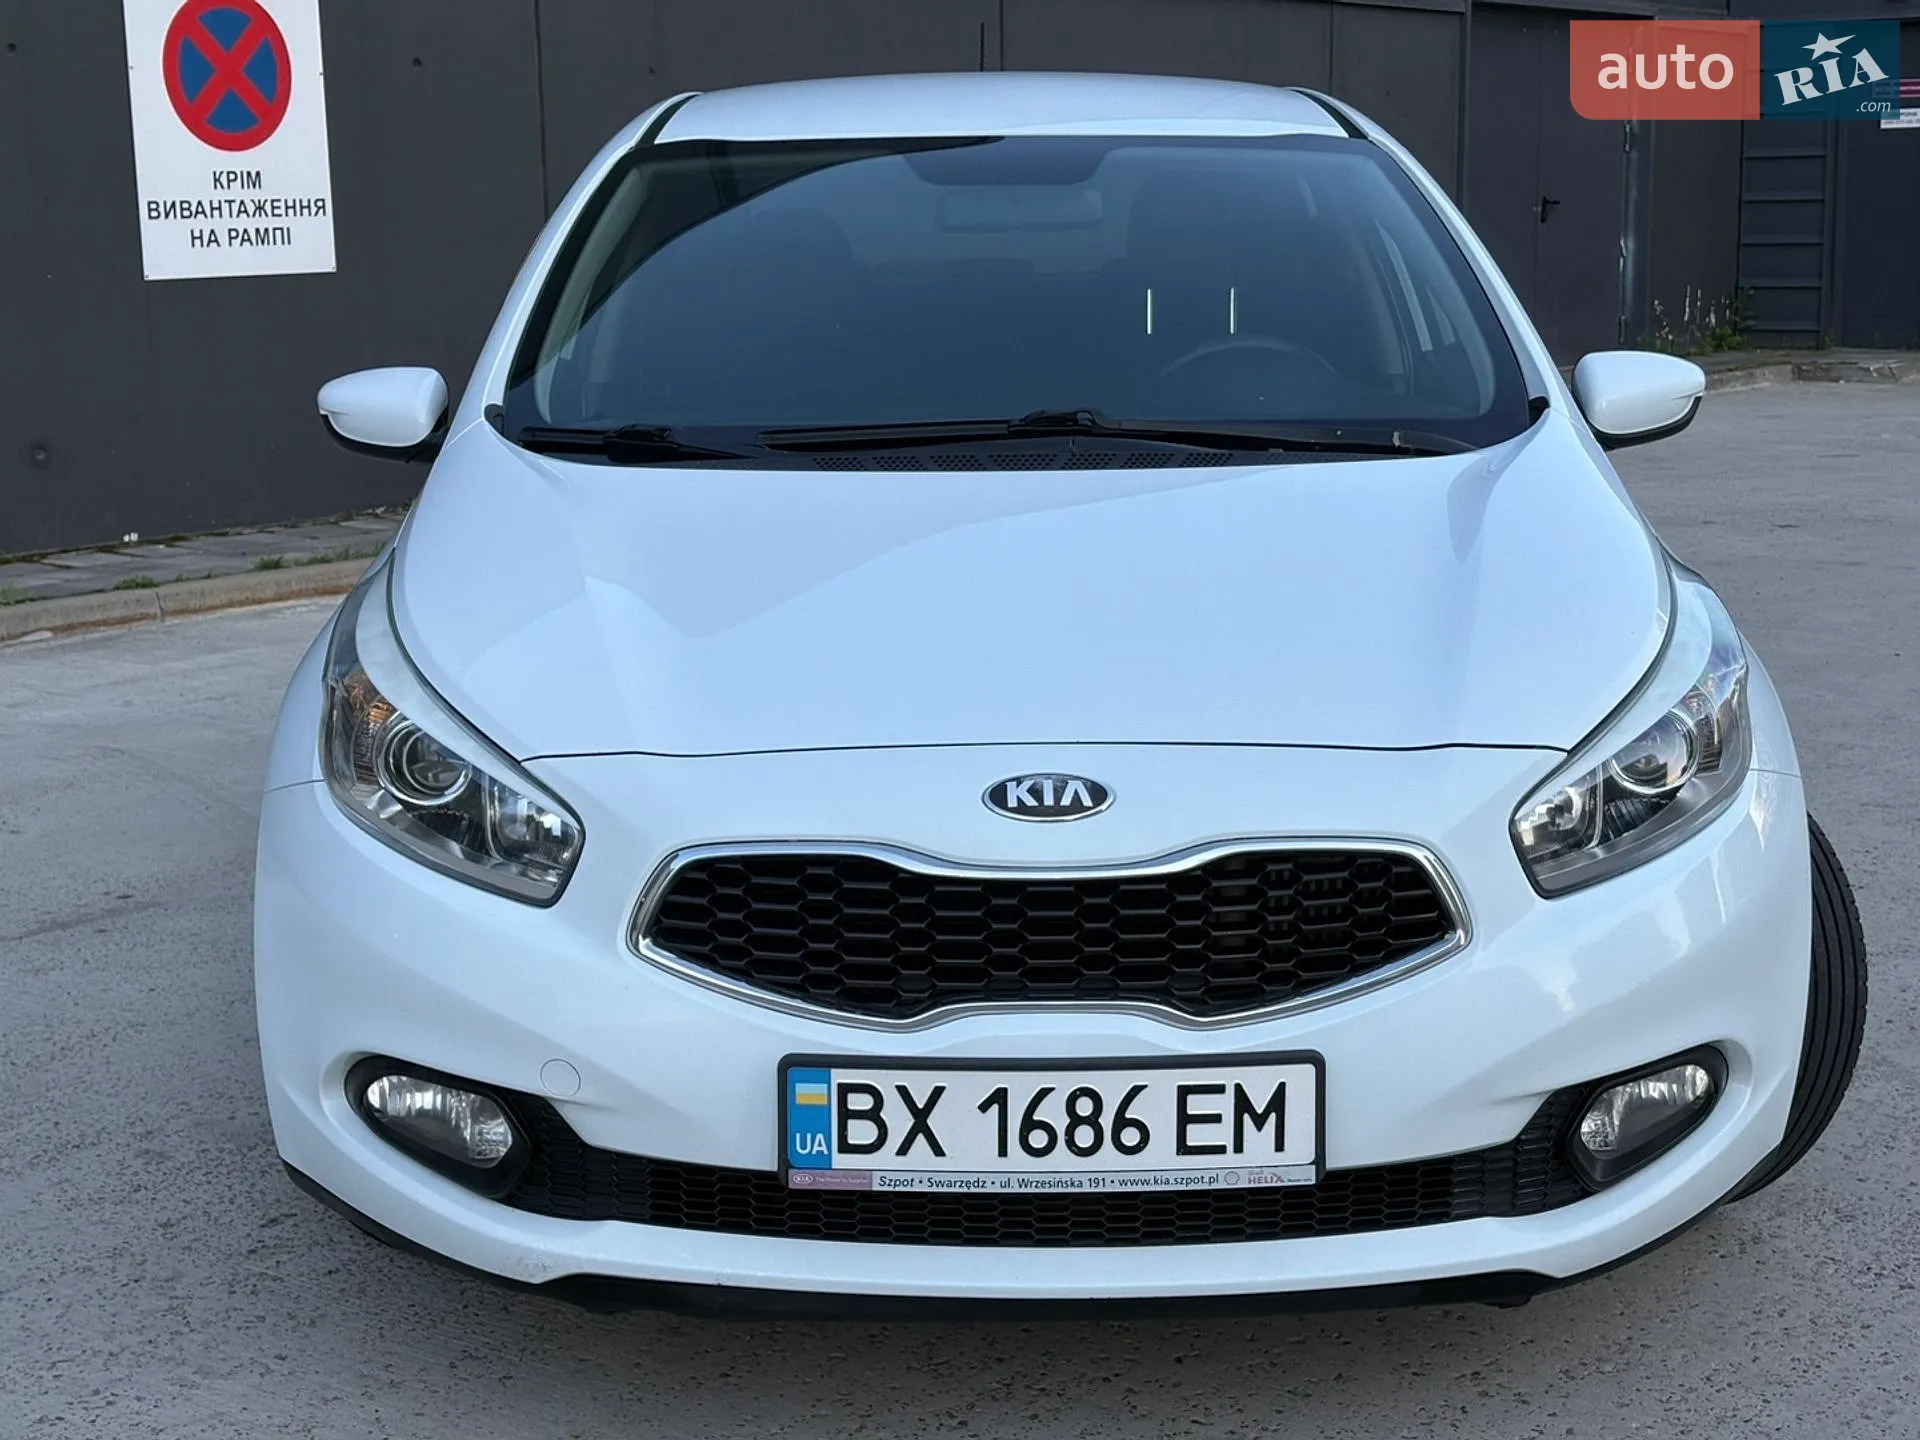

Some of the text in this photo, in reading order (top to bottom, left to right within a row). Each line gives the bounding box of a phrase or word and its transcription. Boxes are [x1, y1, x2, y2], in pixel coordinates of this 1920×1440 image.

[213, 170, 262, 190] КРІМ
[147, 198, 327, 220] ВИВАНТАЖЕННЯ
[190, 227, 292, 248] НА РАМПІ
[1004, 779, 1094, 808] KIA
[837, 1081, 1286, 1158] BX 1686 EM
[795, 1132, 828, 1155] UA
[878, 1175, 915, 1189] Szpot
[927, 1177, 987, 1190] Swarzędz
[1000, 1177, 1014, 1189] ul.
[1017, 1177, 1083, 1189] Wrzesińska
[1087, 1177, 1106, 1188] 191
[1118, 1173, 1219, 1187] www.kia.szpot.pl
[1248, 1175, 1285, 1184] HELIX
